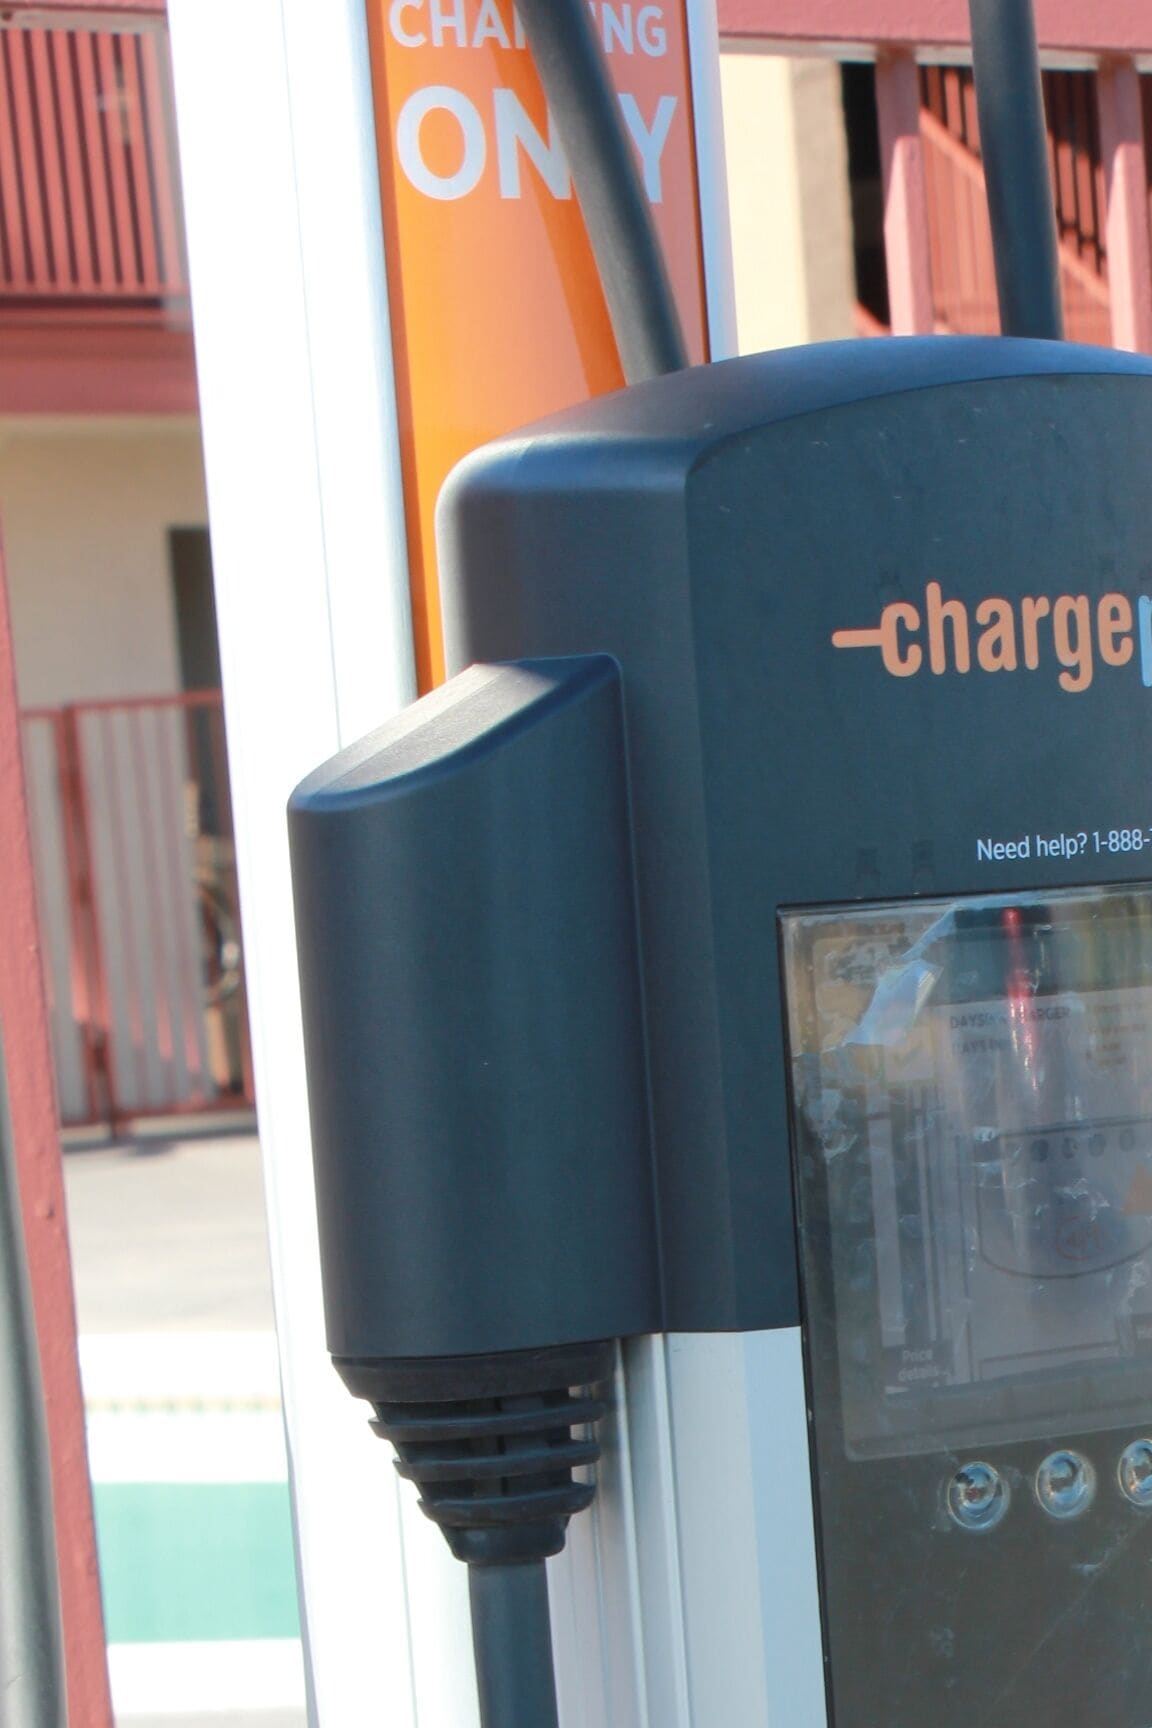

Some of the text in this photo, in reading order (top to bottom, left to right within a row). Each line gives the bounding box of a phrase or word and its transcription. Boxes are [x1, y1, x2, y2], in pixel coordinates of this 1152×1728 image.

[389, 0, 668, 57] CHANG
[396, 85, 678, 203] ONY
[977, 836, 1030, 861] Need
[1036, 831, 1088, 860] help?
